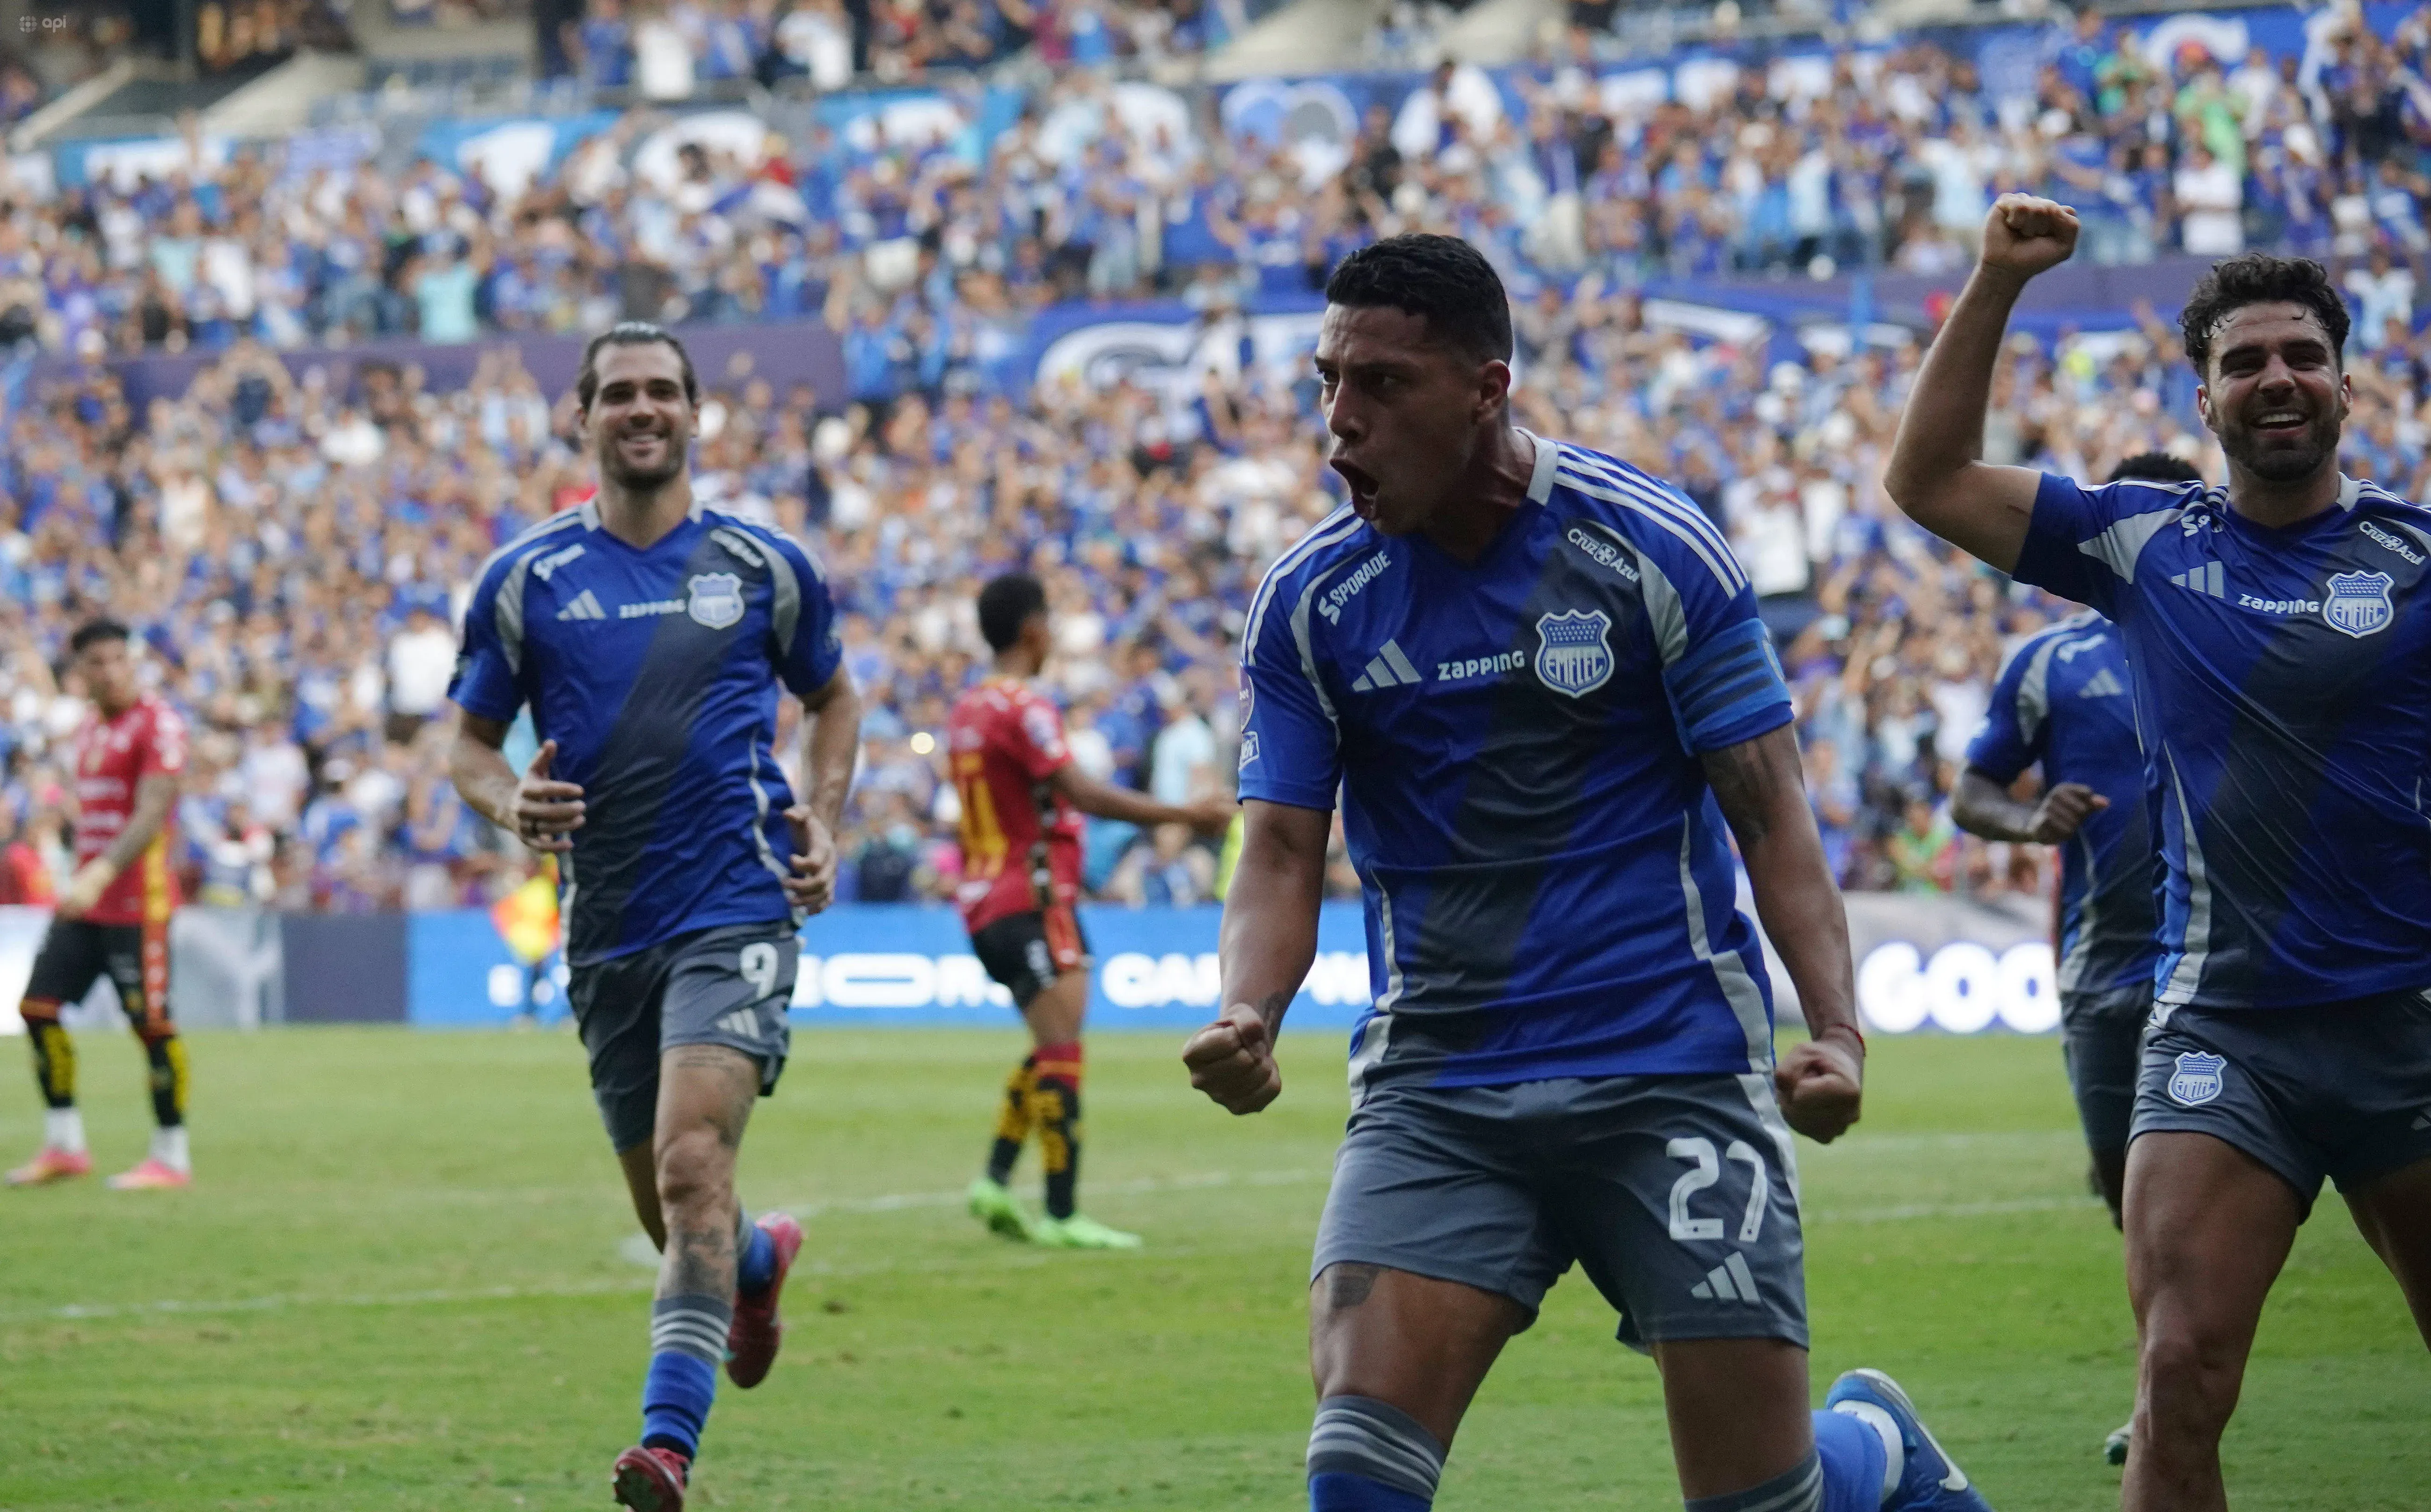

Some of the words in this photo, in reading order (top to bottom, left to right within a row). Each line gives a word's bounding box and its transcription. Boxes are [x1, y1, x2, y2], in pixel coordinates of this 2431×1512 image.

[1329, 550, 1392, 607] SPORADE
[738, 941, 779, 999] 9
[1665, 1136, 1768, 1243] 27
